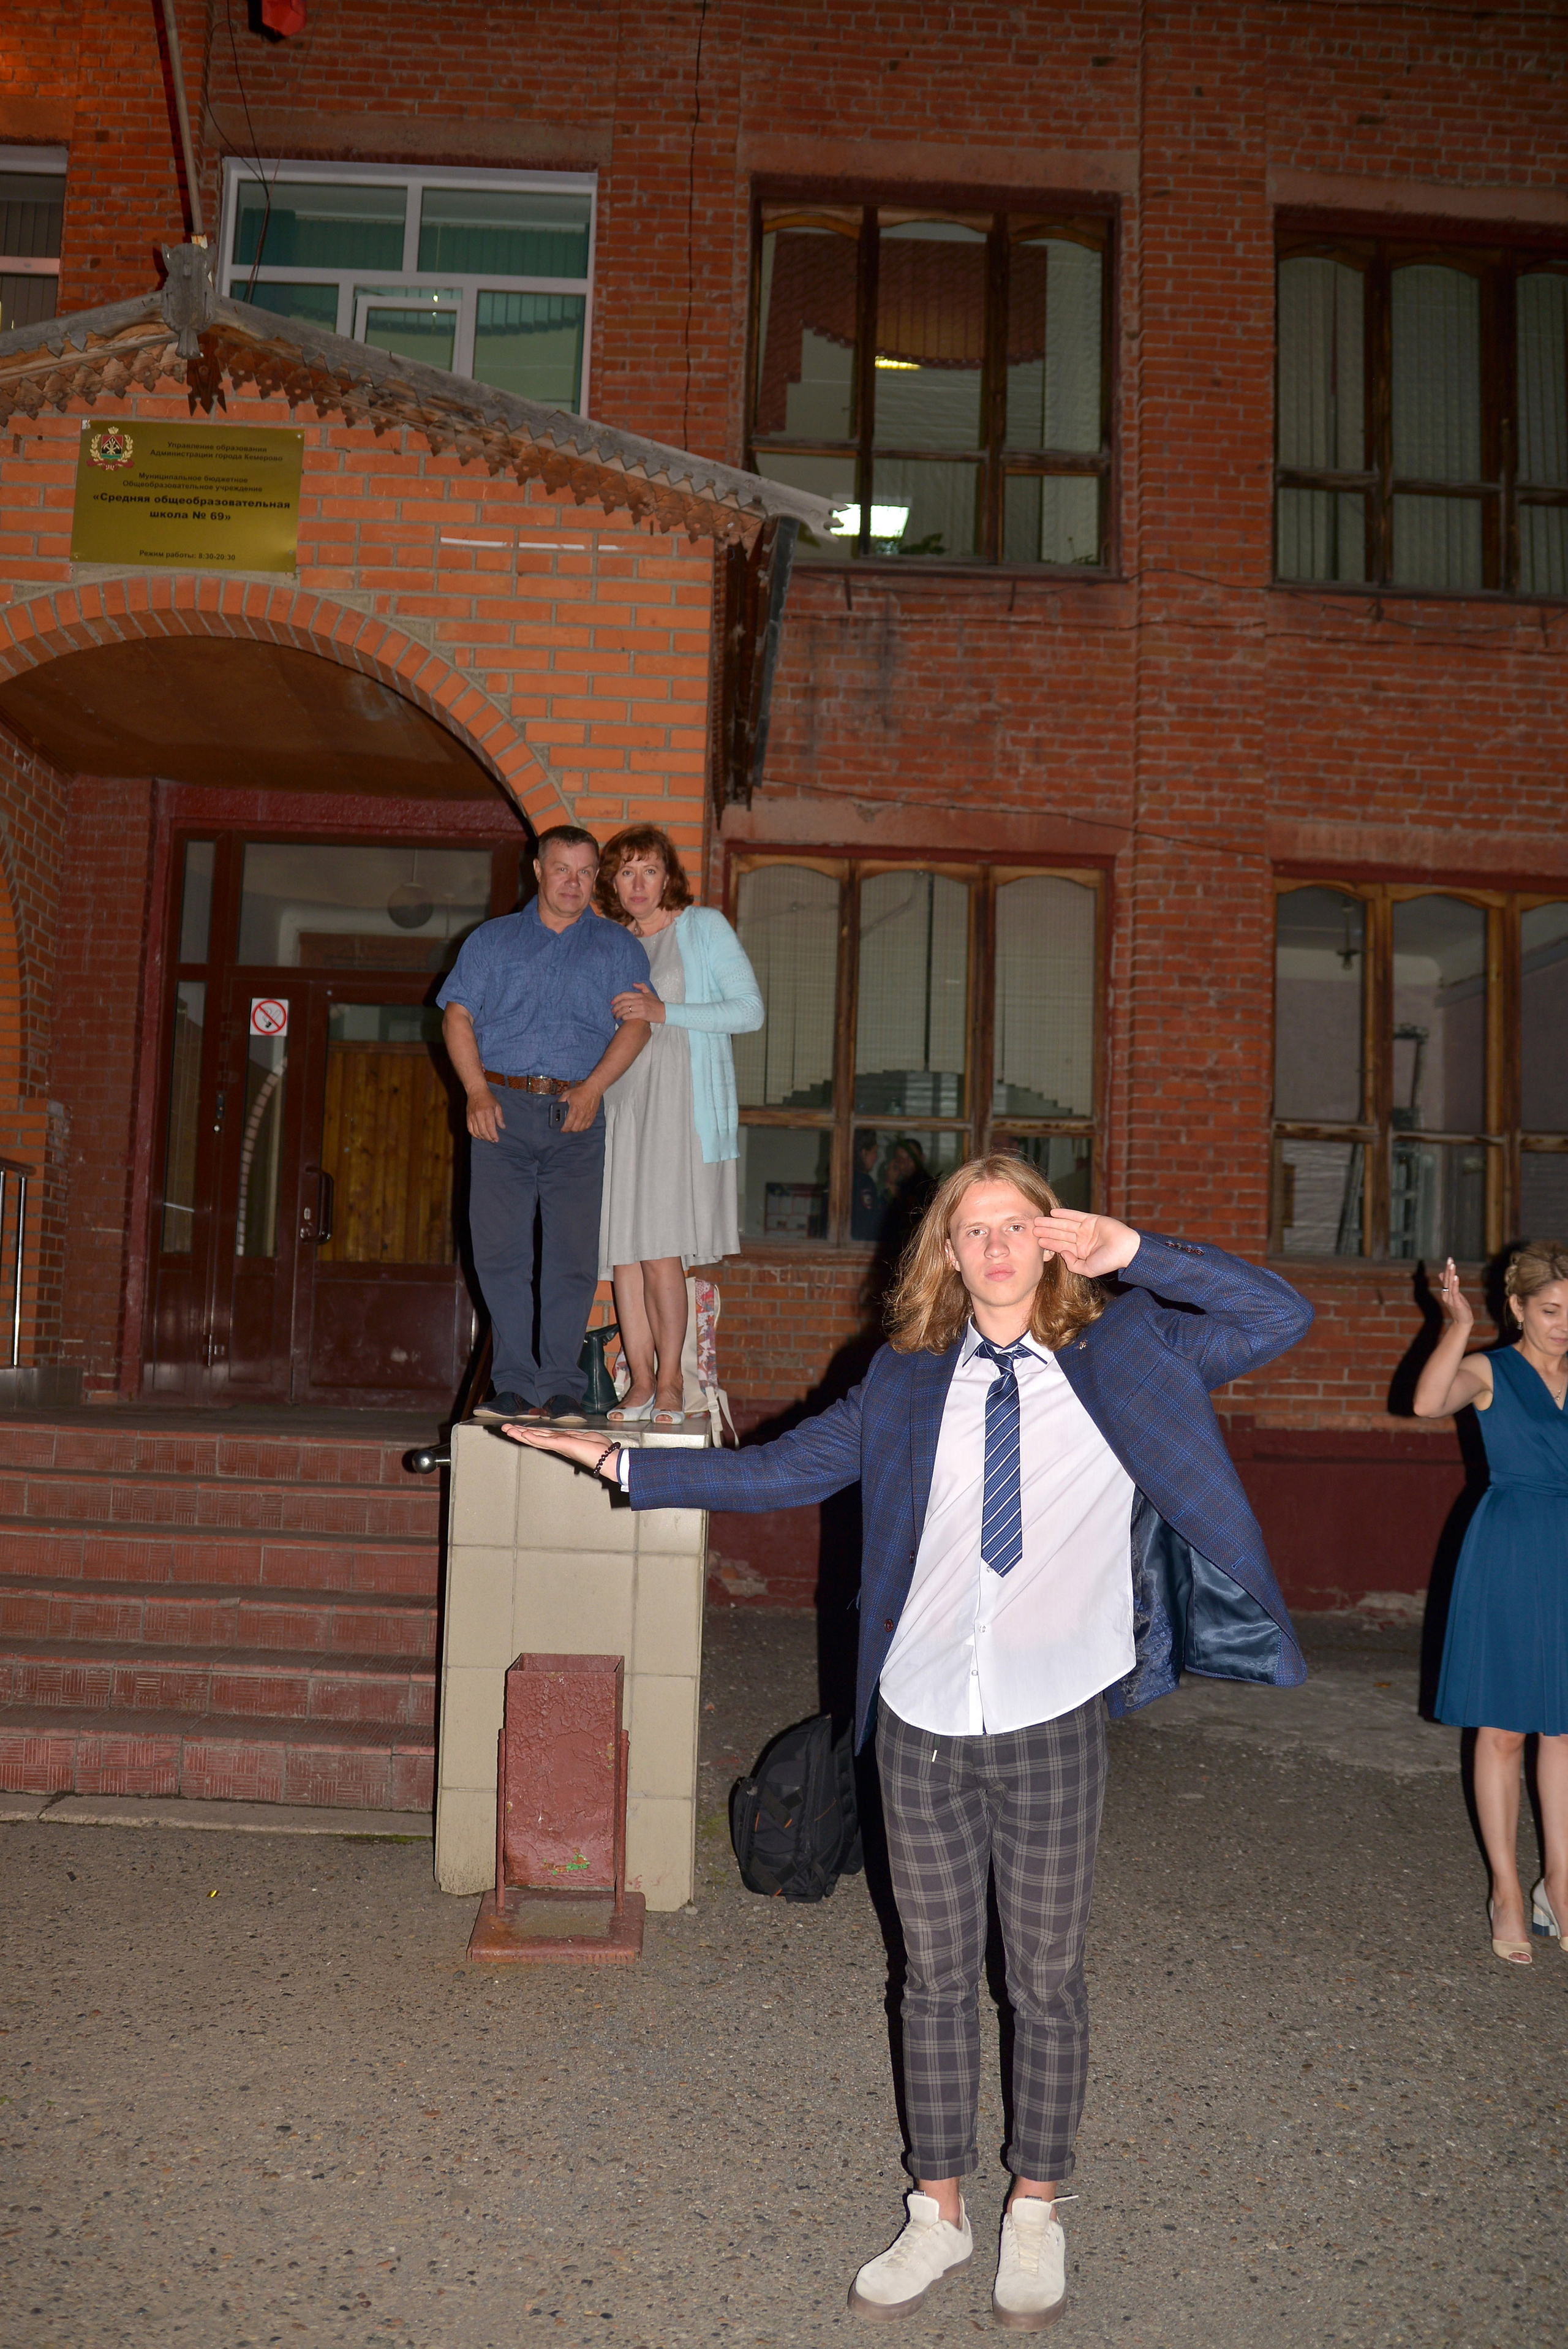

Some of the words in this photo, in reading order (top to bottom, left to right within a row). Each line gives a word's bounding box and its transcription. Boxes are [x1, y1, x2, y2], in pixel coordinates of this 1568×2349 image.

[167, 442, 214, 450] Управление
[150, 450, 213, 459] Администрации
[139, 473, 202, 482] Муниципальное
[123, 480, 213, 490] Общеобразовательное
[94, 493, 149, 504] «Средняя
[154, 496, 290, 509] общеобразовательная
[210, 512, 231, 521] 69»
